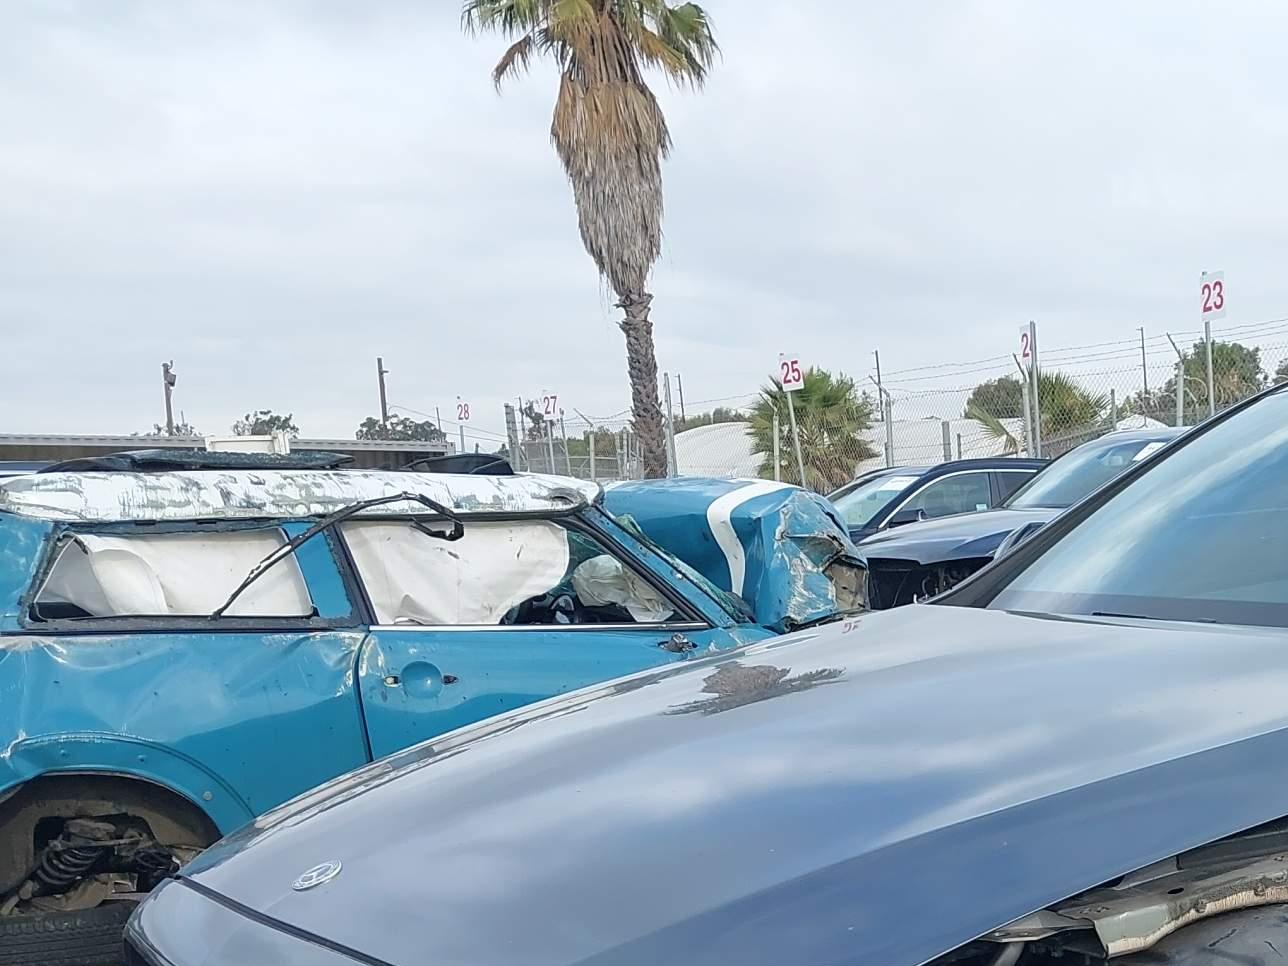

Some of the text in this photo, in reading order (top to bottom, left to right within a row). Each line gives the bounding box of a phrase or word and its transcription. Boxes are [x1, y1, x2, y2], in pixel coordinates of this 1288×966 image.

[1201, 280, 1224, 313] 23
[781, 360, 801, 384] 25
[457, 403, 470, 420] 28
[543, 395, 557, 415] 27
